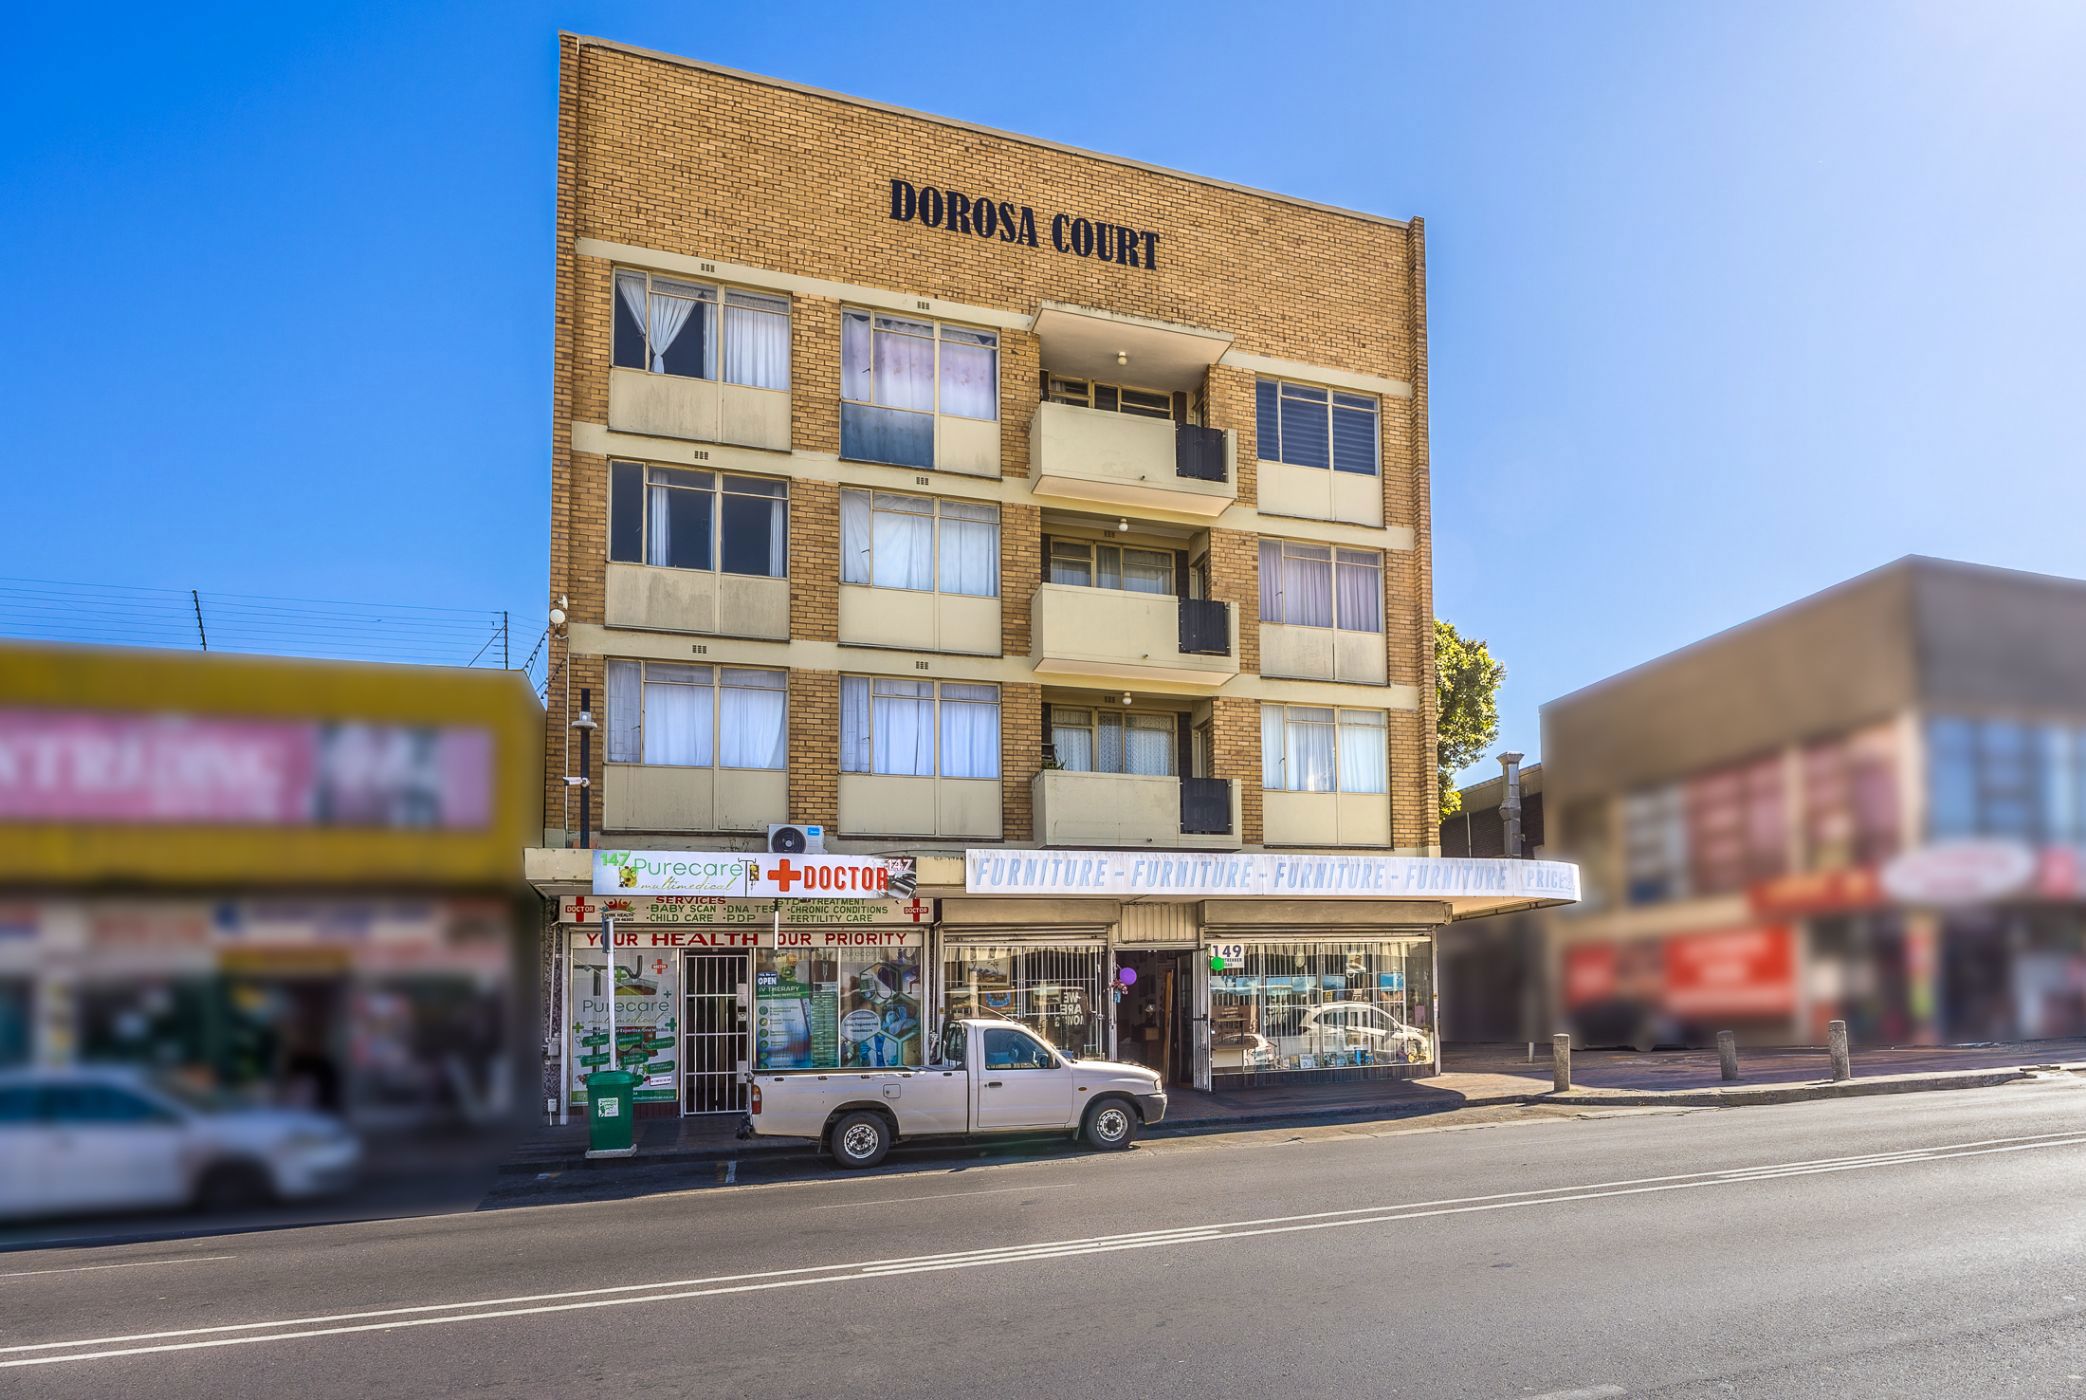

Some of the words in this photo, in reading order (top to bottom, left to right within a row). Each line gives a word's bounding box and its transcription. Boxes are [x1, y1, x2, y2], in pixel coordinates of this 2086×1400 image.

[889, 178, 1039, 248] DOROSA
[1052, 213, 1160, 271] COURT
[600, 850, 631, 867] 147
[634, 858, 743, 876] Purecare
[803, 865, 889, 891] DOCTOR
[975, 858, 1108, 887] FURNITURE
[1131, 860, 1252, 888] FURNITURE
[1274, 862, 1385, 889] FURNITURE
[1407, 863, 1507, 890] FURNITURE
[640, 875, 737, 891] multimedical
[656, 896, 726, 904] SERVICES
[650, 904, 685, 913] BABY
[690, 905, 717, 913] SCAN
[727, 905, 750, 913] DNA
[790, 905, 829, 914] CHRONIC
[833, 905, 888, 914] CONDITIONS
[650, 914, 679, 922] CHILD
[684, 914, 713, 922] CARE
[727, 914, 756, 922] PDP
[790, 914, 842, 923] FERTILITY
[846, 914, 873, 923] CARE
[587, 933, 638, 946] YUR
[651, 932, 758, 946] HEALTH
[778, 933, 812, 945] OUR
[825, 933, 907, 946] PRIORITY
[1213, 945, 1242, 957] 149
[757, 977, 777, 985] OPEN
